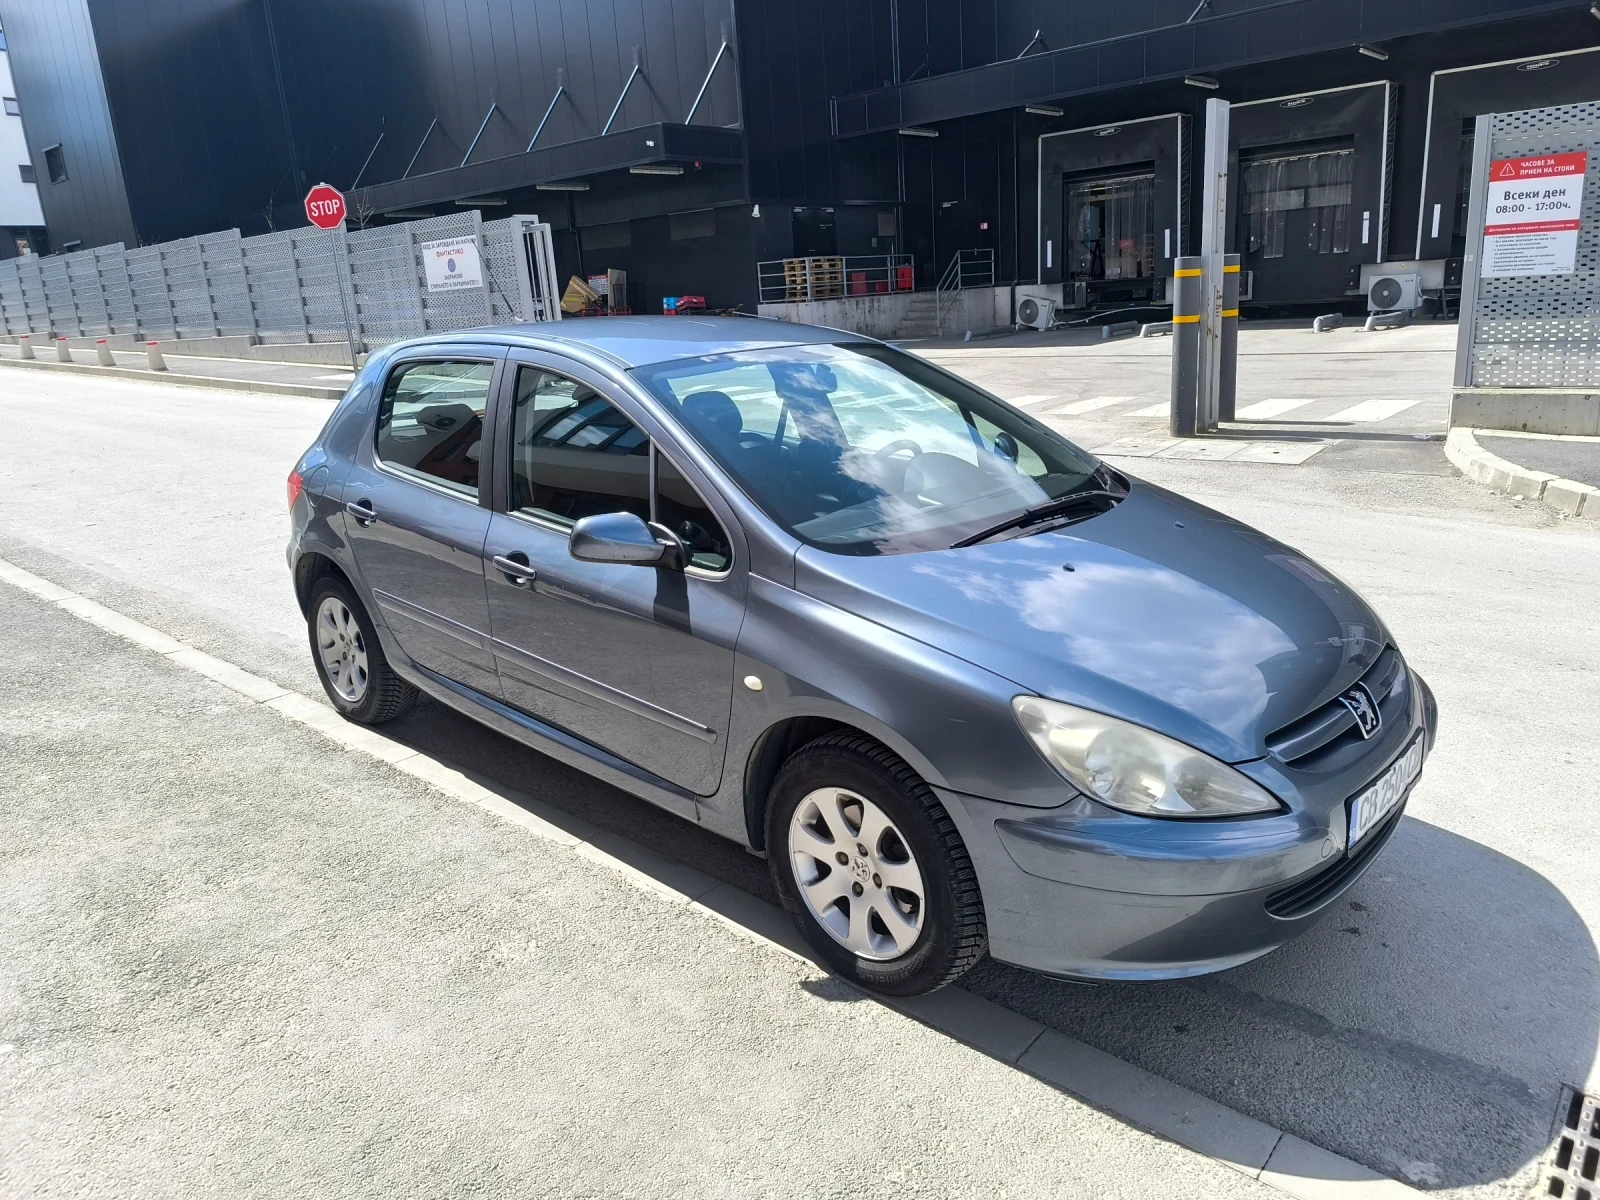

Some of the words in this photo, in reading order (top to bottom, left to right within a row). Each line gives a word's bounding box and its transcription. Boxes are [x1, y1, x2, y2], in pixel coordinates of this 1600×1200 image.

[1520, 160, 1545, 168] ЧАСОВЕ
[1519, 167, 1542, 176] ПРИЕМ
[1543, 166, 1553, 174] НА
[1554, 165, 1575, 173] СТОКИ
[1503, 190, 1540, 201] Всеки
[1542, 188, 1566, 200] ден
[310, 199, 341, 217] STOP
[1495, 204, 1525, 214] 08:00
[1535, 201, 1571, 211] 17:00ч.
[436, 248, 464, 257] ФАНТАСТИКО
